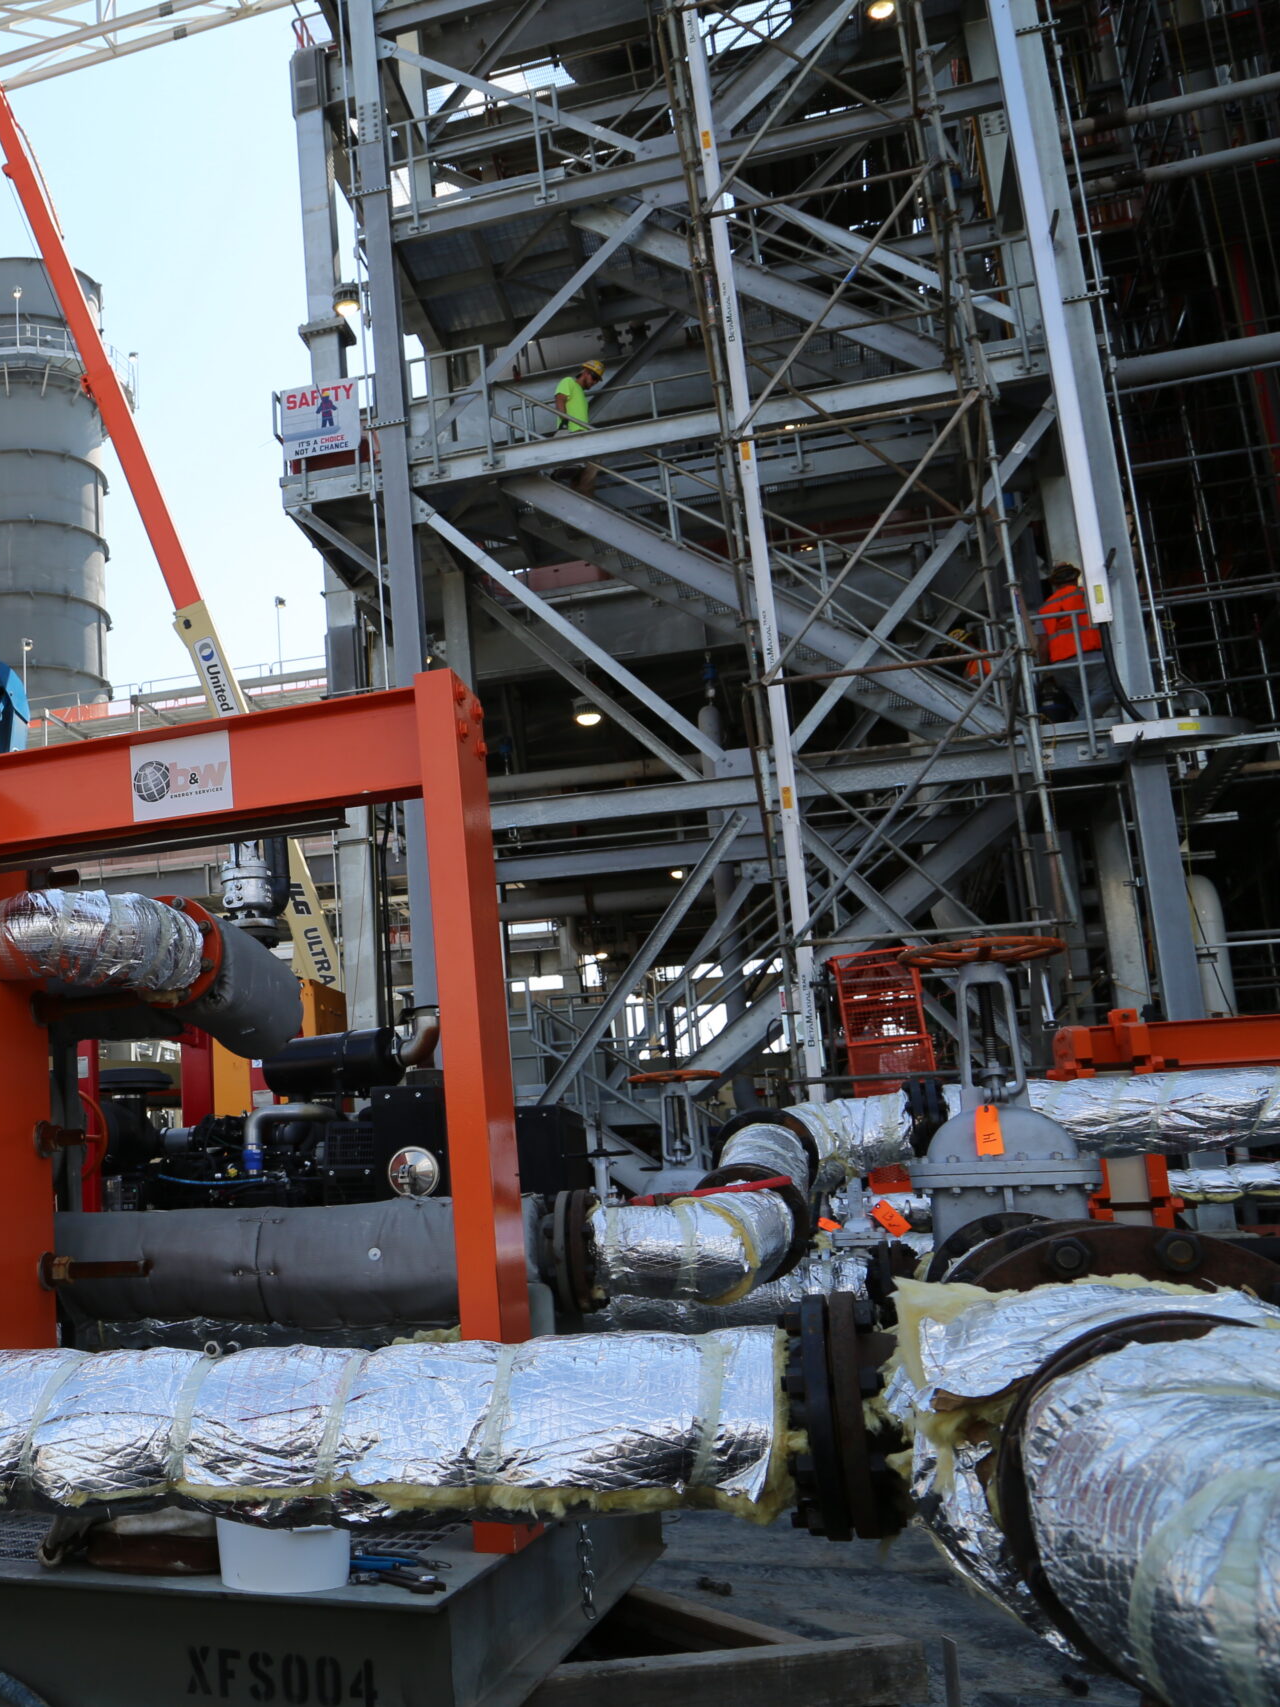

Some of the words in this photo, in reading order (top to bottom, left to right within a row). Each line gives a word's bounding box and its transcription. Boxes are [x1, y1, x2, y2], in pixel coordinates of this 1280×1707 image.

[294, 448, 308, 457] NOT
[312, 446, 317, 454] A
[319, 441, 349, 452] CHANCE
[298, 440, 311, 448] IT'S
[320, 434, 345, 444] CHOICE
[206, 664, 234, 712] United
[170, 790, 193, 799] ENERGY
[194, 786, 223, 796] SERVICES
[304, 927, 336, 986] ULTRA
[186, 1645, 379, 1707] XFS004
